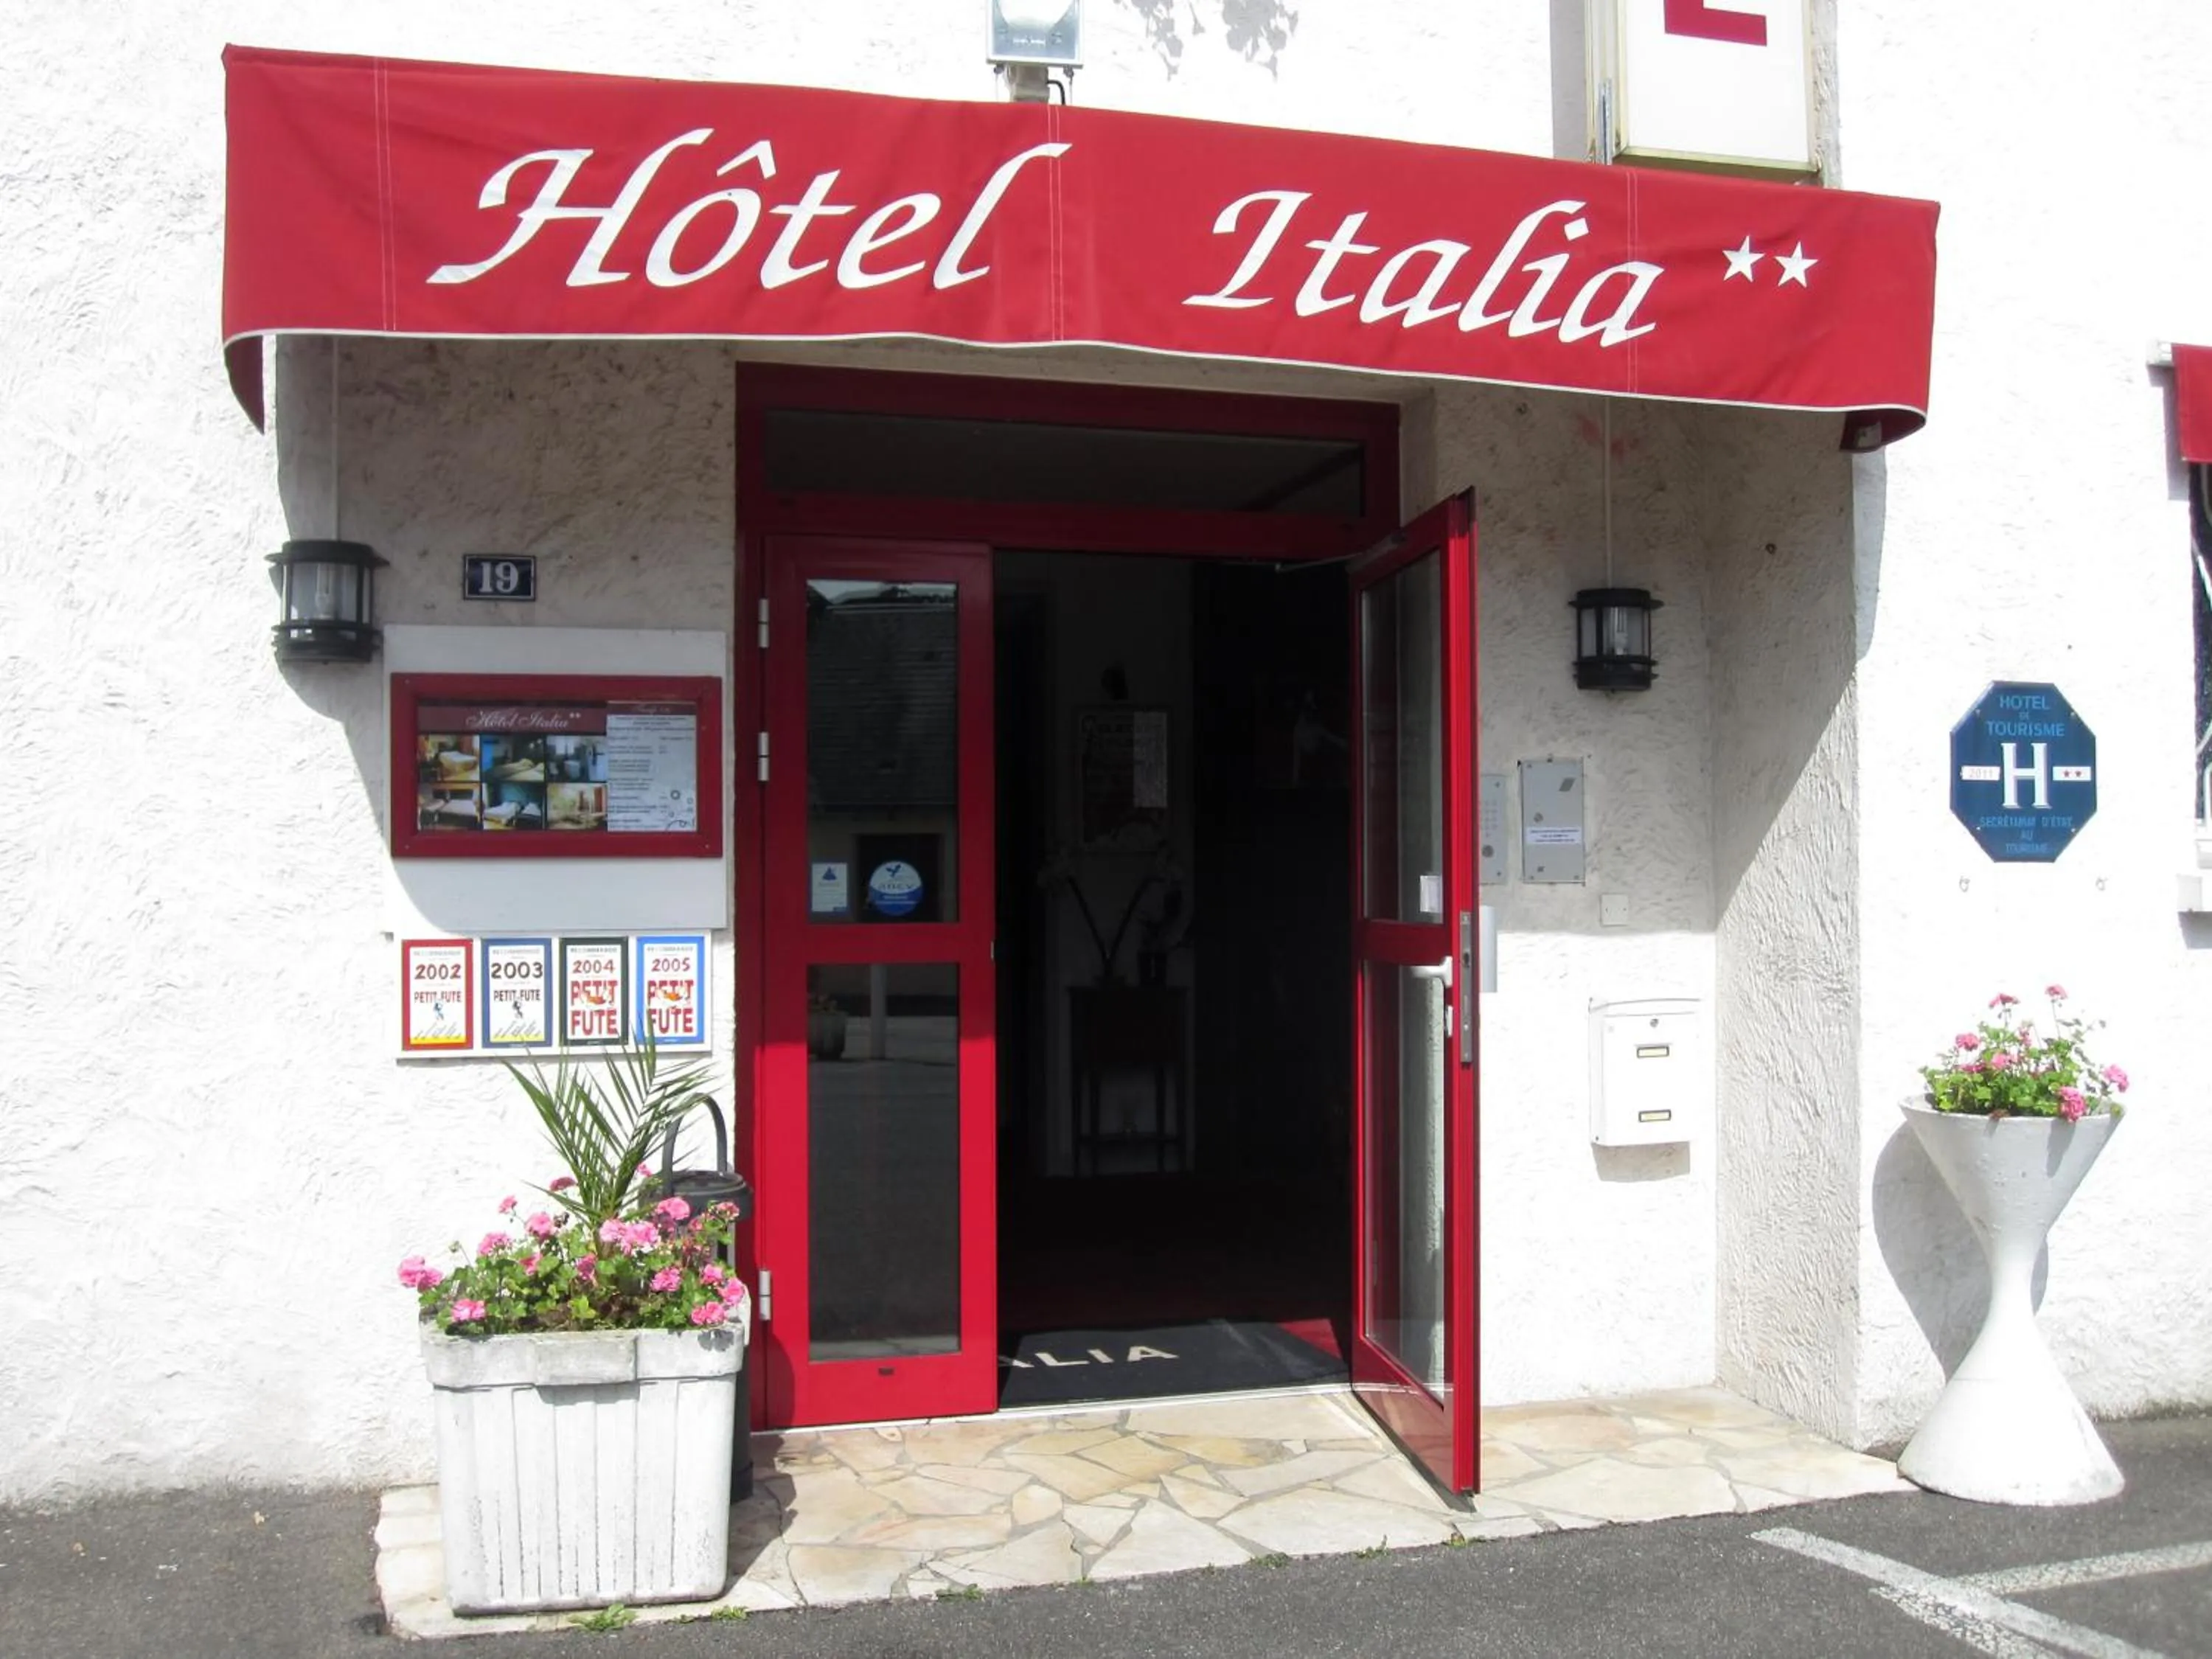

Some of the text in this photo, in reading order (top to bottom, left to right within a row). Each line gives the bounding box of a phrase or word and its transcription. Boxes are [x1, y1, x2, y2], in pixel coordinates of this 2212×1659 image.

[427, 128, 1663, 348] Hôtel Italia
[479, 561, 518, 593] 19
[1999, 695, 2051, 710] HOTEL
[1986, 720, 2065, 737] TOURISME
[2001, 742, 2052, 809] H
[414, 964, 462, 980] 2002
[491, 961, 543, 979] 2003
[573, 959, 616, 973] 2004
[651, 958, 691, 973] 2005
